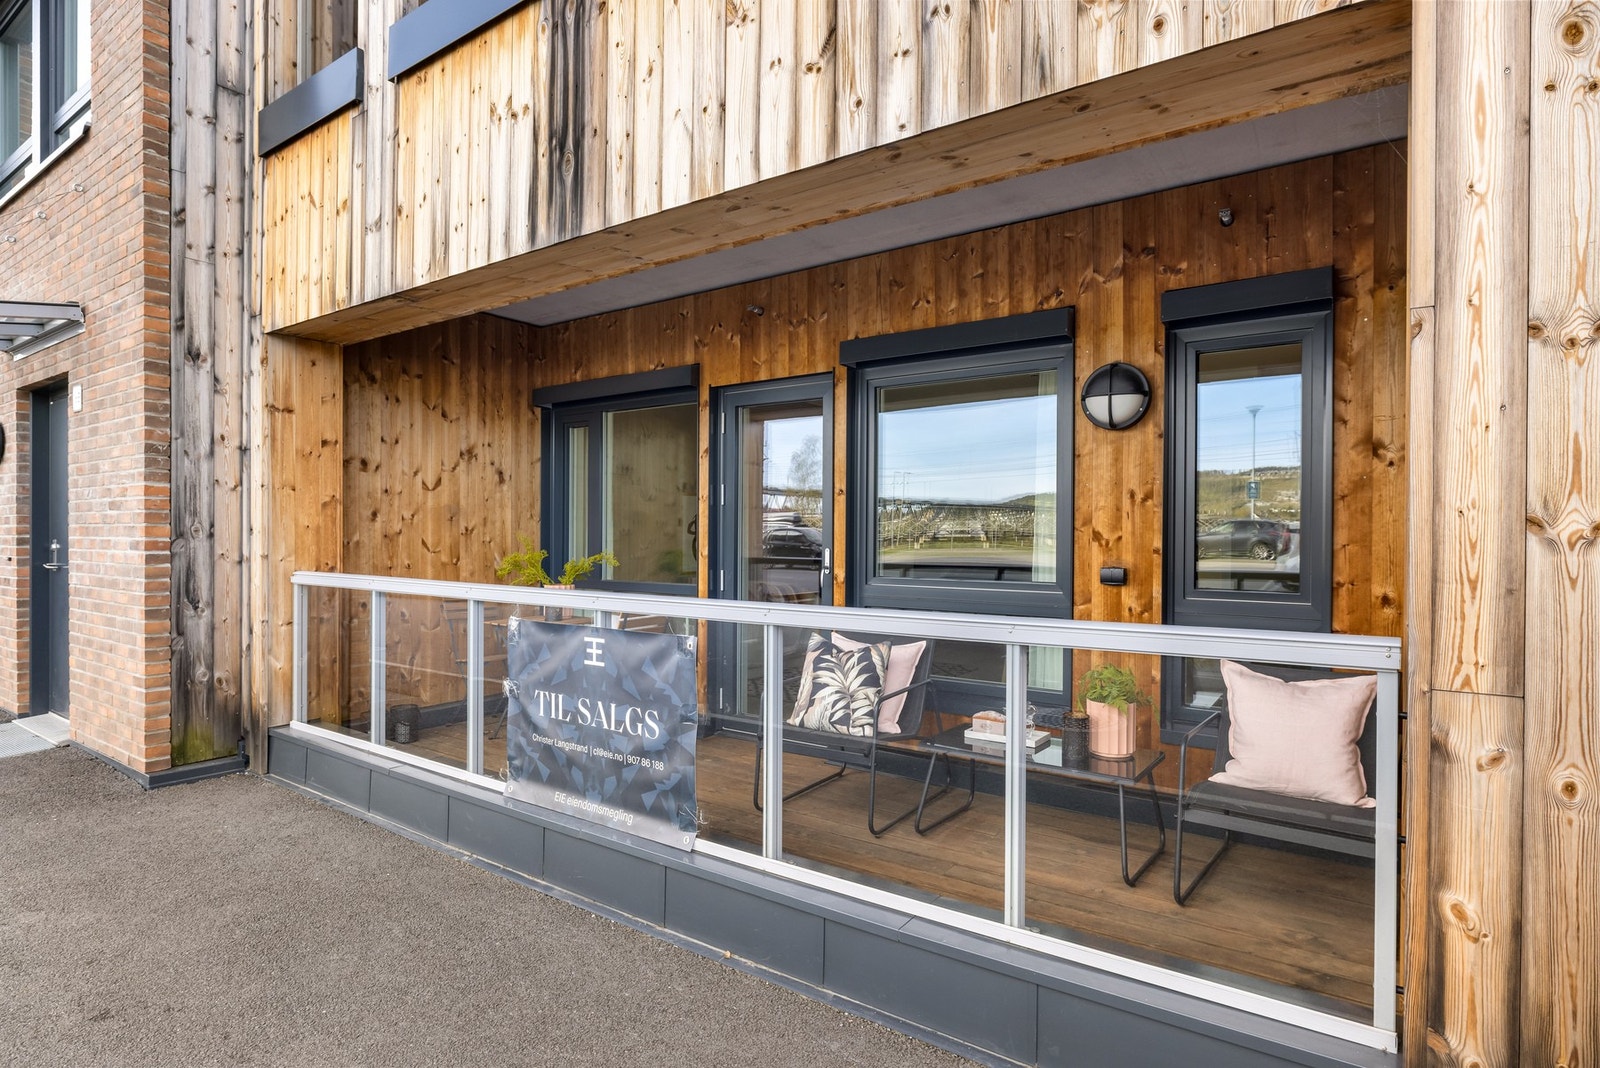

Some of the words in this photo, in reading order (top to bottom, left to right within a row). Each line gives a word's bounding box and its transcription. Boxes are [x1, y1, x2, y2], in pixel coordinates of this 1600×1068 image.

[534, 690, 572, 722] TIL
[577, 697, 660, 739] SALGS
[532, 733, 554, 745] Christer
[554, 738, 589, 754] Langstrand
[627, 755, 641, 766] 907
[640, 758, 651, 768] 86
[651, 760, 665, 771] 188
[554, 791, 567, 804] EIE
[566, 795, 634, 826] eiendomsmegling
